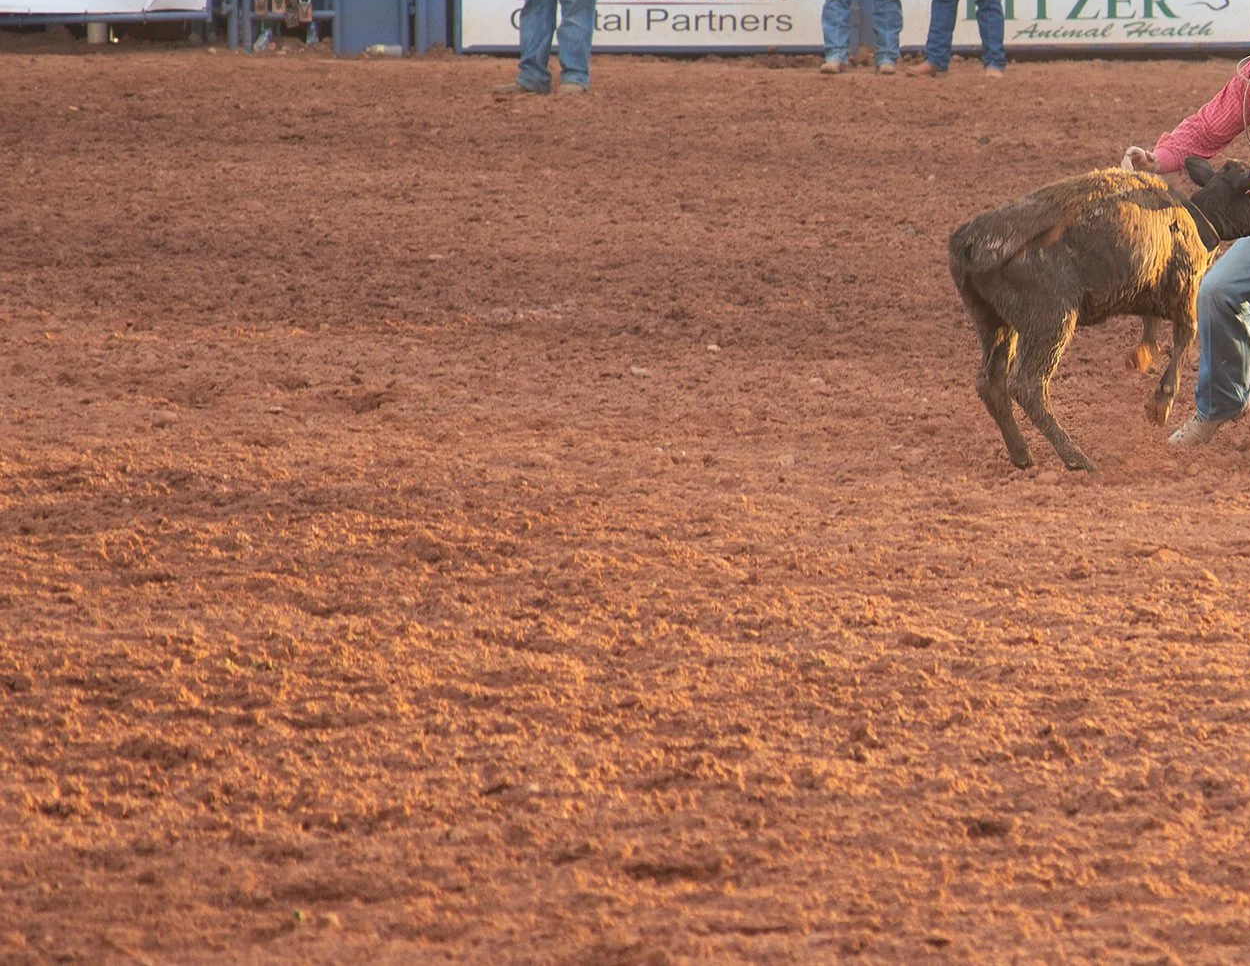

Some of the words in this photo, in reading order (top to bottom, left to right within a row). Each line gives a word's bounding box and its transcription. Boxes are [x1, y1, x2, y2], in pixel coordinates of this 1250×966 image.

[646, 8, 793, 31] Partners
[1012, 23, 1112, 40] Animal
[1122, 20, 1215, 38] Health
